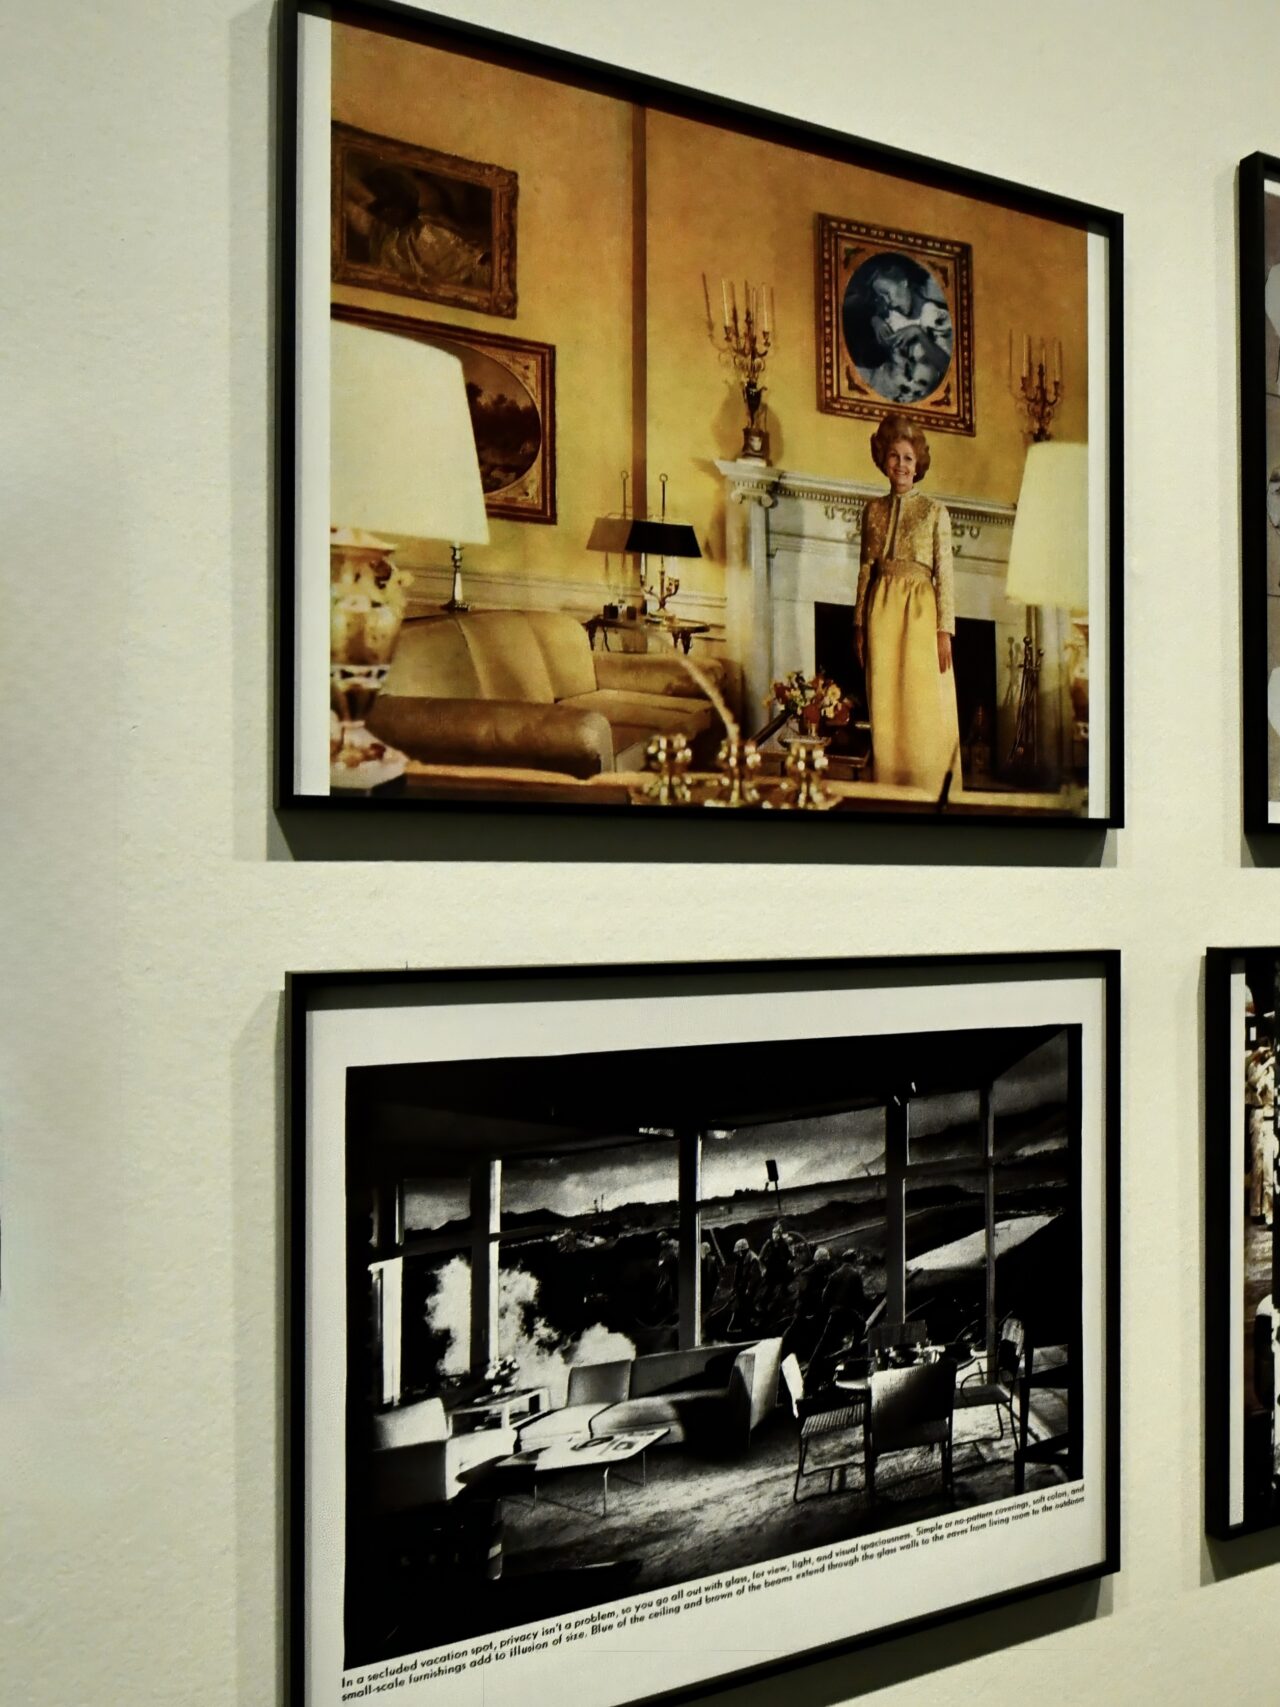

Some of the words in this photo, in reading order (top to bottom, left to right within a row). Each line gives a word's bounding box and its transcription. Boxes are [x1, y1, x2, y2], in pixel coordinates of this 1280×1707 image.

[341, 1676, 353, 1688] In
[356, 1676, 364, 1684] a
[367, 1659, 418, 1681] secluded
[420, 1649, 468, 1668] vacation
[471, 1641, 497, 1656] spot,
[500, 1629, 539, 1649] privacy
[541, 1623, 562, 1637] isn't
[564, 1622, 572, 1630] a
[574, 1610, 619, 1629] problem,
[621, 1606, 632, 1615] so
[635, 1601, 653, 1614] you
[655, 1596, 669, 1607] go
[671, 1589, 684, 1601] all
[686, 1586, 701, 1597] out
[704, 1579, 722, 1592] with
[725, 1575, 750, 1589] glass,
[752, 1570, 765, 1580] for
[767, 1564, 790, 1576] view,
[792, 1557, 814, 1570] light,
[816, 1550, 833, 1562] and
[835, 1543, 859, 1557] visual
[861, 1532, 913, 1552] spaciousness.
[916, 1522, 943, 1536] Simple
[945, 1521, 953, 1529] or
[995, 1500, 1031, 1516] coverings,
[1032, 1495, 1045, 1505] soft
[1070, 1482, 1085, 1495] and
[341, 1677, 405, 1702] small-scale
[408, 1663, 466, 1684] furnishings
[469, 1653, 492, 1668] add
[495, 1652, 506, 1661] to
[509, 1641, 548, 1658] illusion
[552, 1635, 562, 1646] of
[591, 1623, 614, 1636] Blue
[616, 1616, 627, 1628] of
[629, 1613, 645, 1625] the
[648, 1605, 681, 1620] ceiling
[683, 1596, 703, 1610] and
[705, 1591, 733, 1604] brown
[735, 1585, 746, 1596] of
[748, 1581, 762, 1593] the
[764, 1575, 793, 1589] beams
[796, 1566, 825, 1580] extend
[827, 1555, 860, 1571] through
[861, 1551, 875, 1562] the
[876, 1547, 897, 1559] glass
[899, 1539, 920, 1552] walls
[921, 1537, 930, 1546] to
[931, 1533, 944, 1543] the
[970, 1522, 987, 1532] from
[988, 1516, 1010, 1528] living
[1011, 1511, 1030, 1521] room
[1032, 1508, 1040, 1517] to
[1041, 1504, 1053, 1513] the
